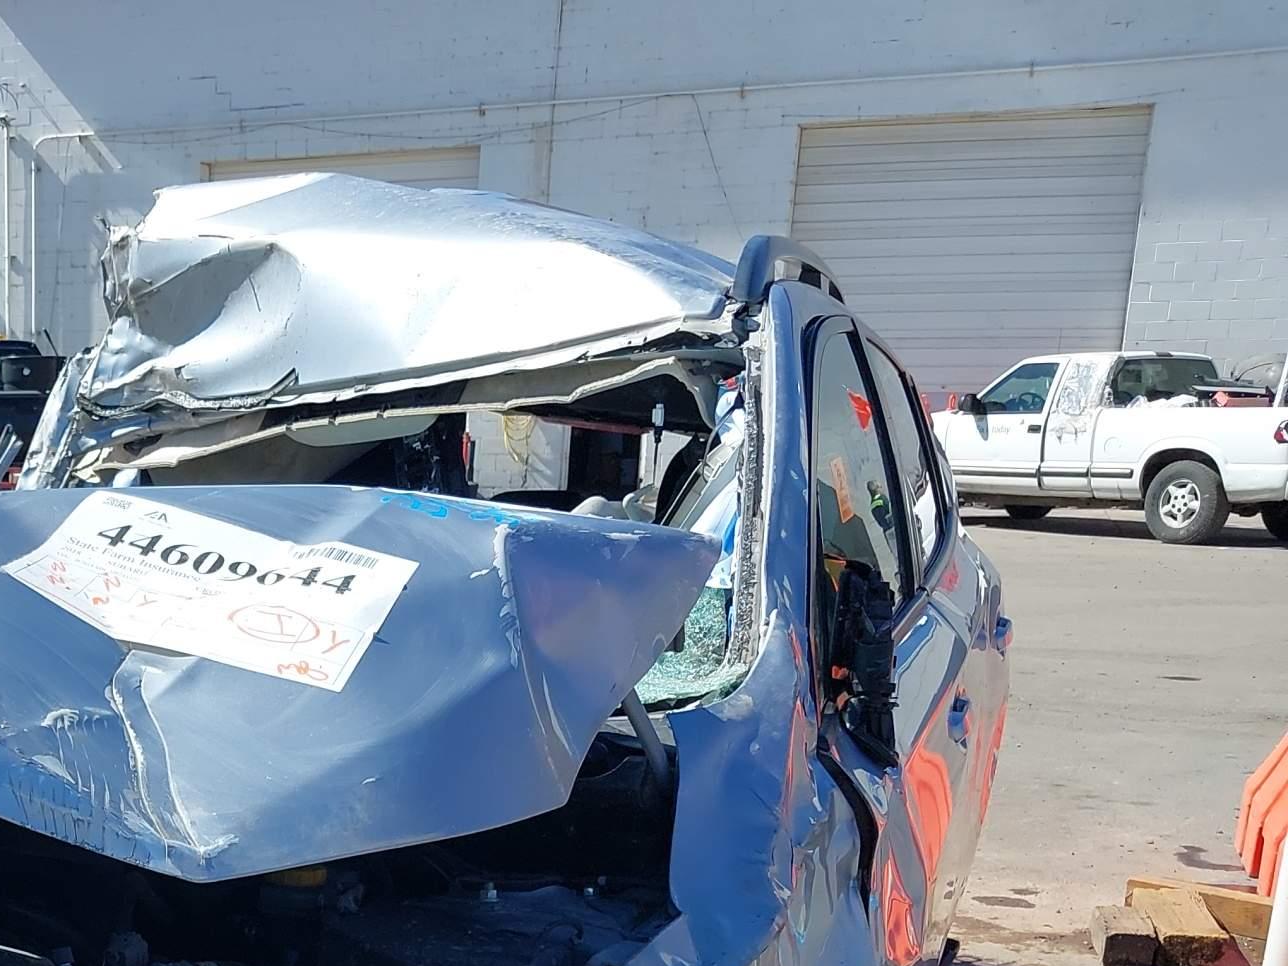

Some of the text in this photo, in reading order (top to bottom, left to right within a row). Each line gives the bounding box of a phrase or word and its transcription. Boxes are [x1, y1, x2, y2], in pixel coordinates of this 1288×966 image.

[66, 536, 100, 552] State
[101, 547, 136, 565] Farm
[139, 559, 202, 582] Insurance
[96, 524, 357, 595] 44609644
